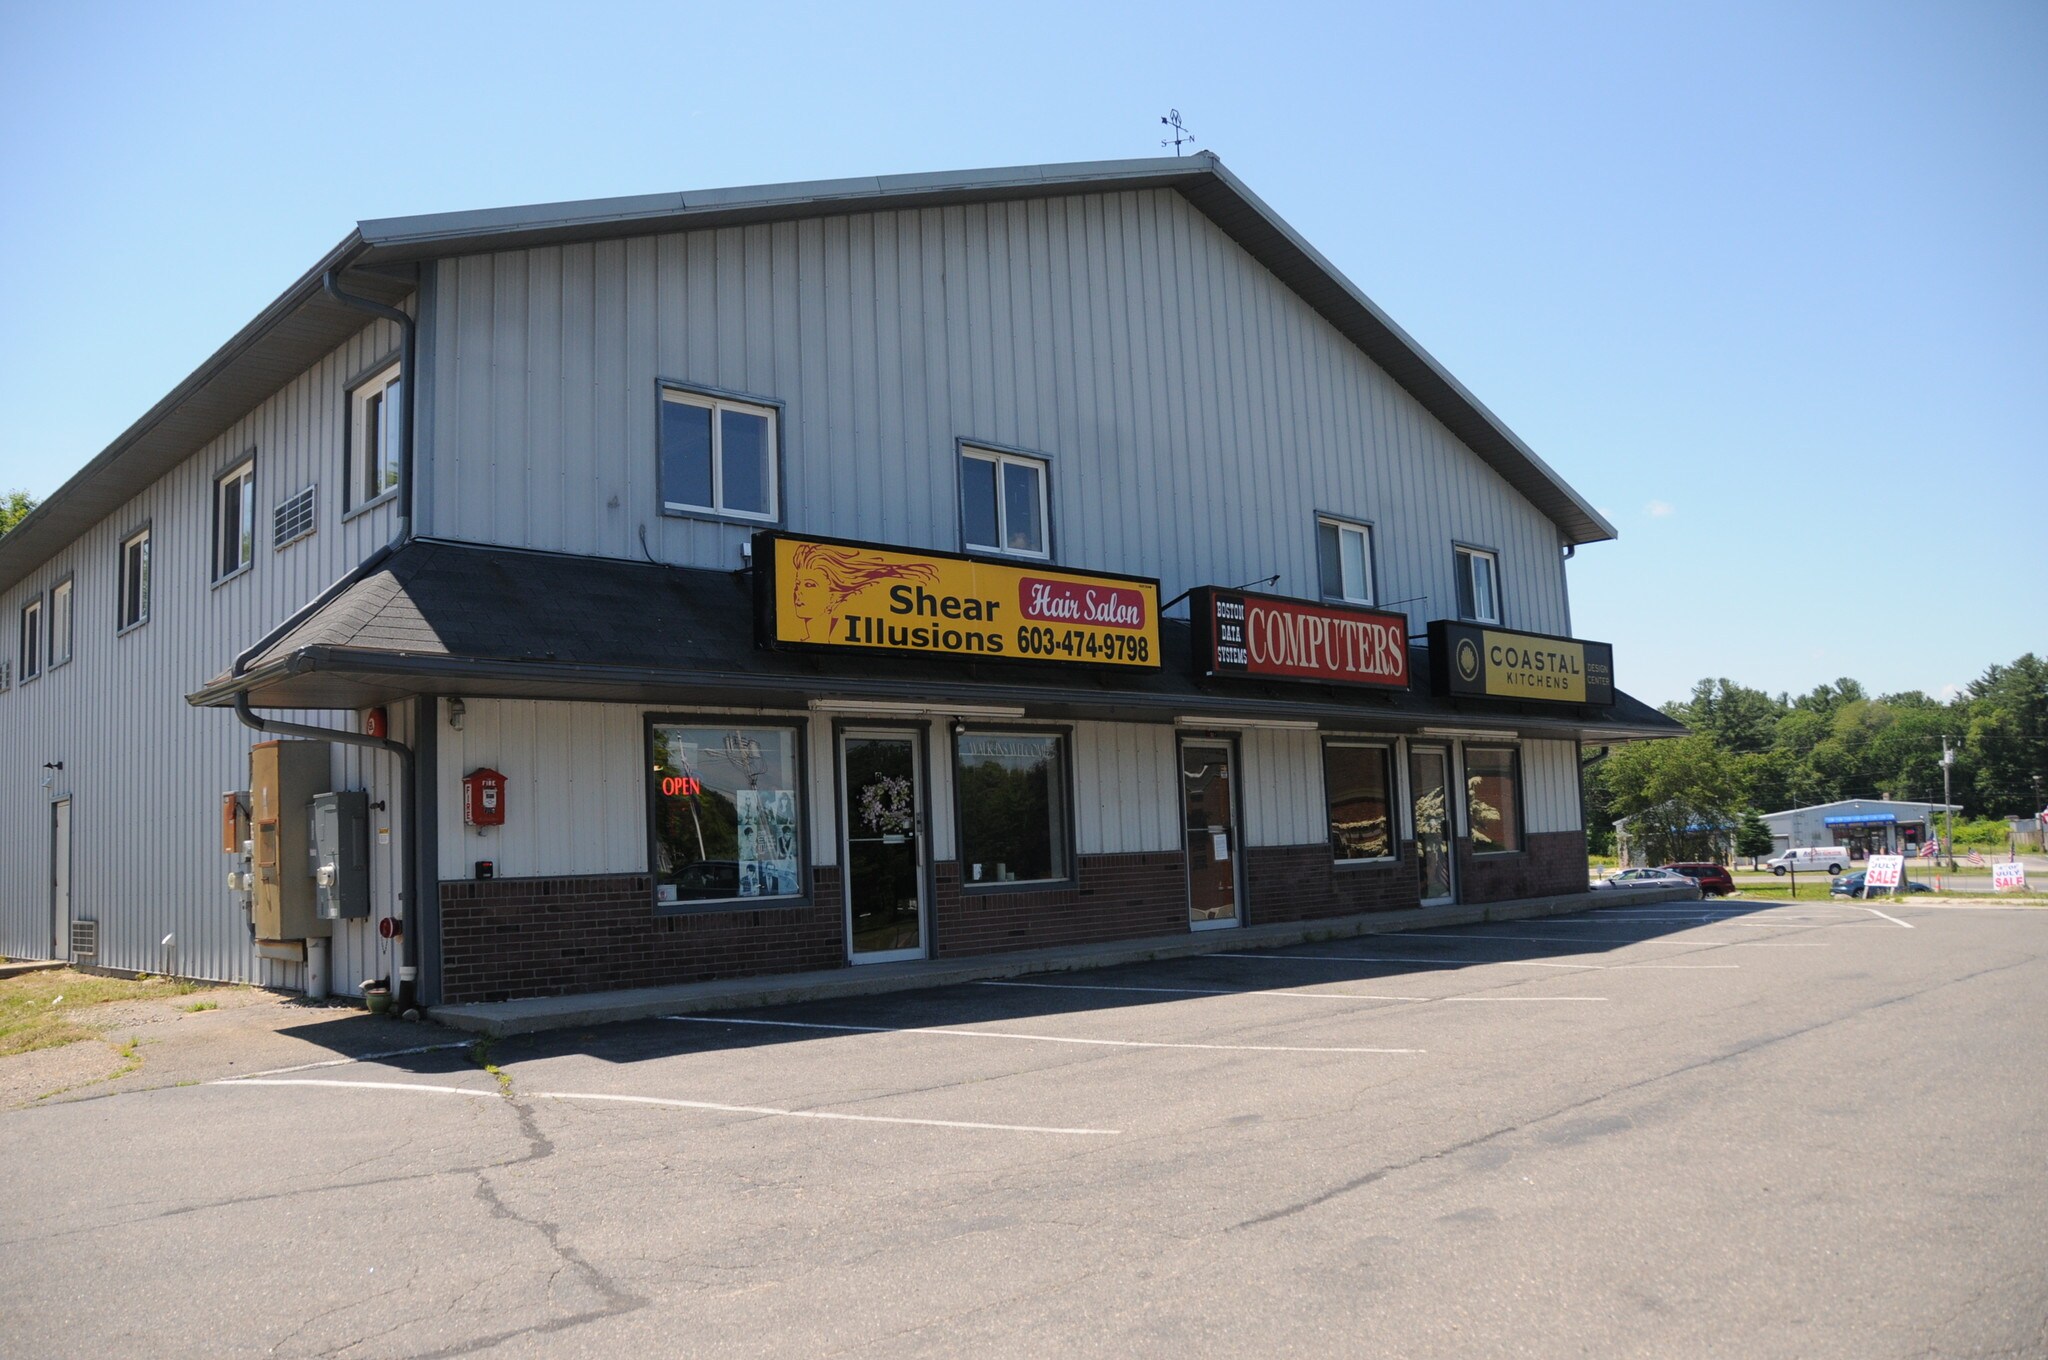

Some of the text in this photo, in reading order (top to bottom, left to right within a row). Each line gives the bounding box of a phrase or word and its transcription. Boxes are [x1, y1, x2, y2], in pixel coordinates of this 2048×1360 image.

[889, 584, 1000, 622] Shear
[1028, 583, 1140, 625] Hair Salon
[1216, 601, 1244, 620] BOSTON
[845, 614, 1004, 652] Illusions
[1221, 624, 1241, 642] DATA
[1248, 607, 1403, 677] COMPUTERS
[1017, 625, 1149, 662] 603-474-9798
[1217, 646, 1248, 664] SYSTEMS
[1491, 645, 1580, 675] COASTAL
[1587, 663, 1609, 674] DESIGN
[1507, 672, 1569, 690] KITCHENS
[1587, 675, 1611, 686] CENTER
[662, 776, 700, 796] OPEN
[1871, 862, 1899, 870] JULY
[1867, 869, 1899, 885] SALE
